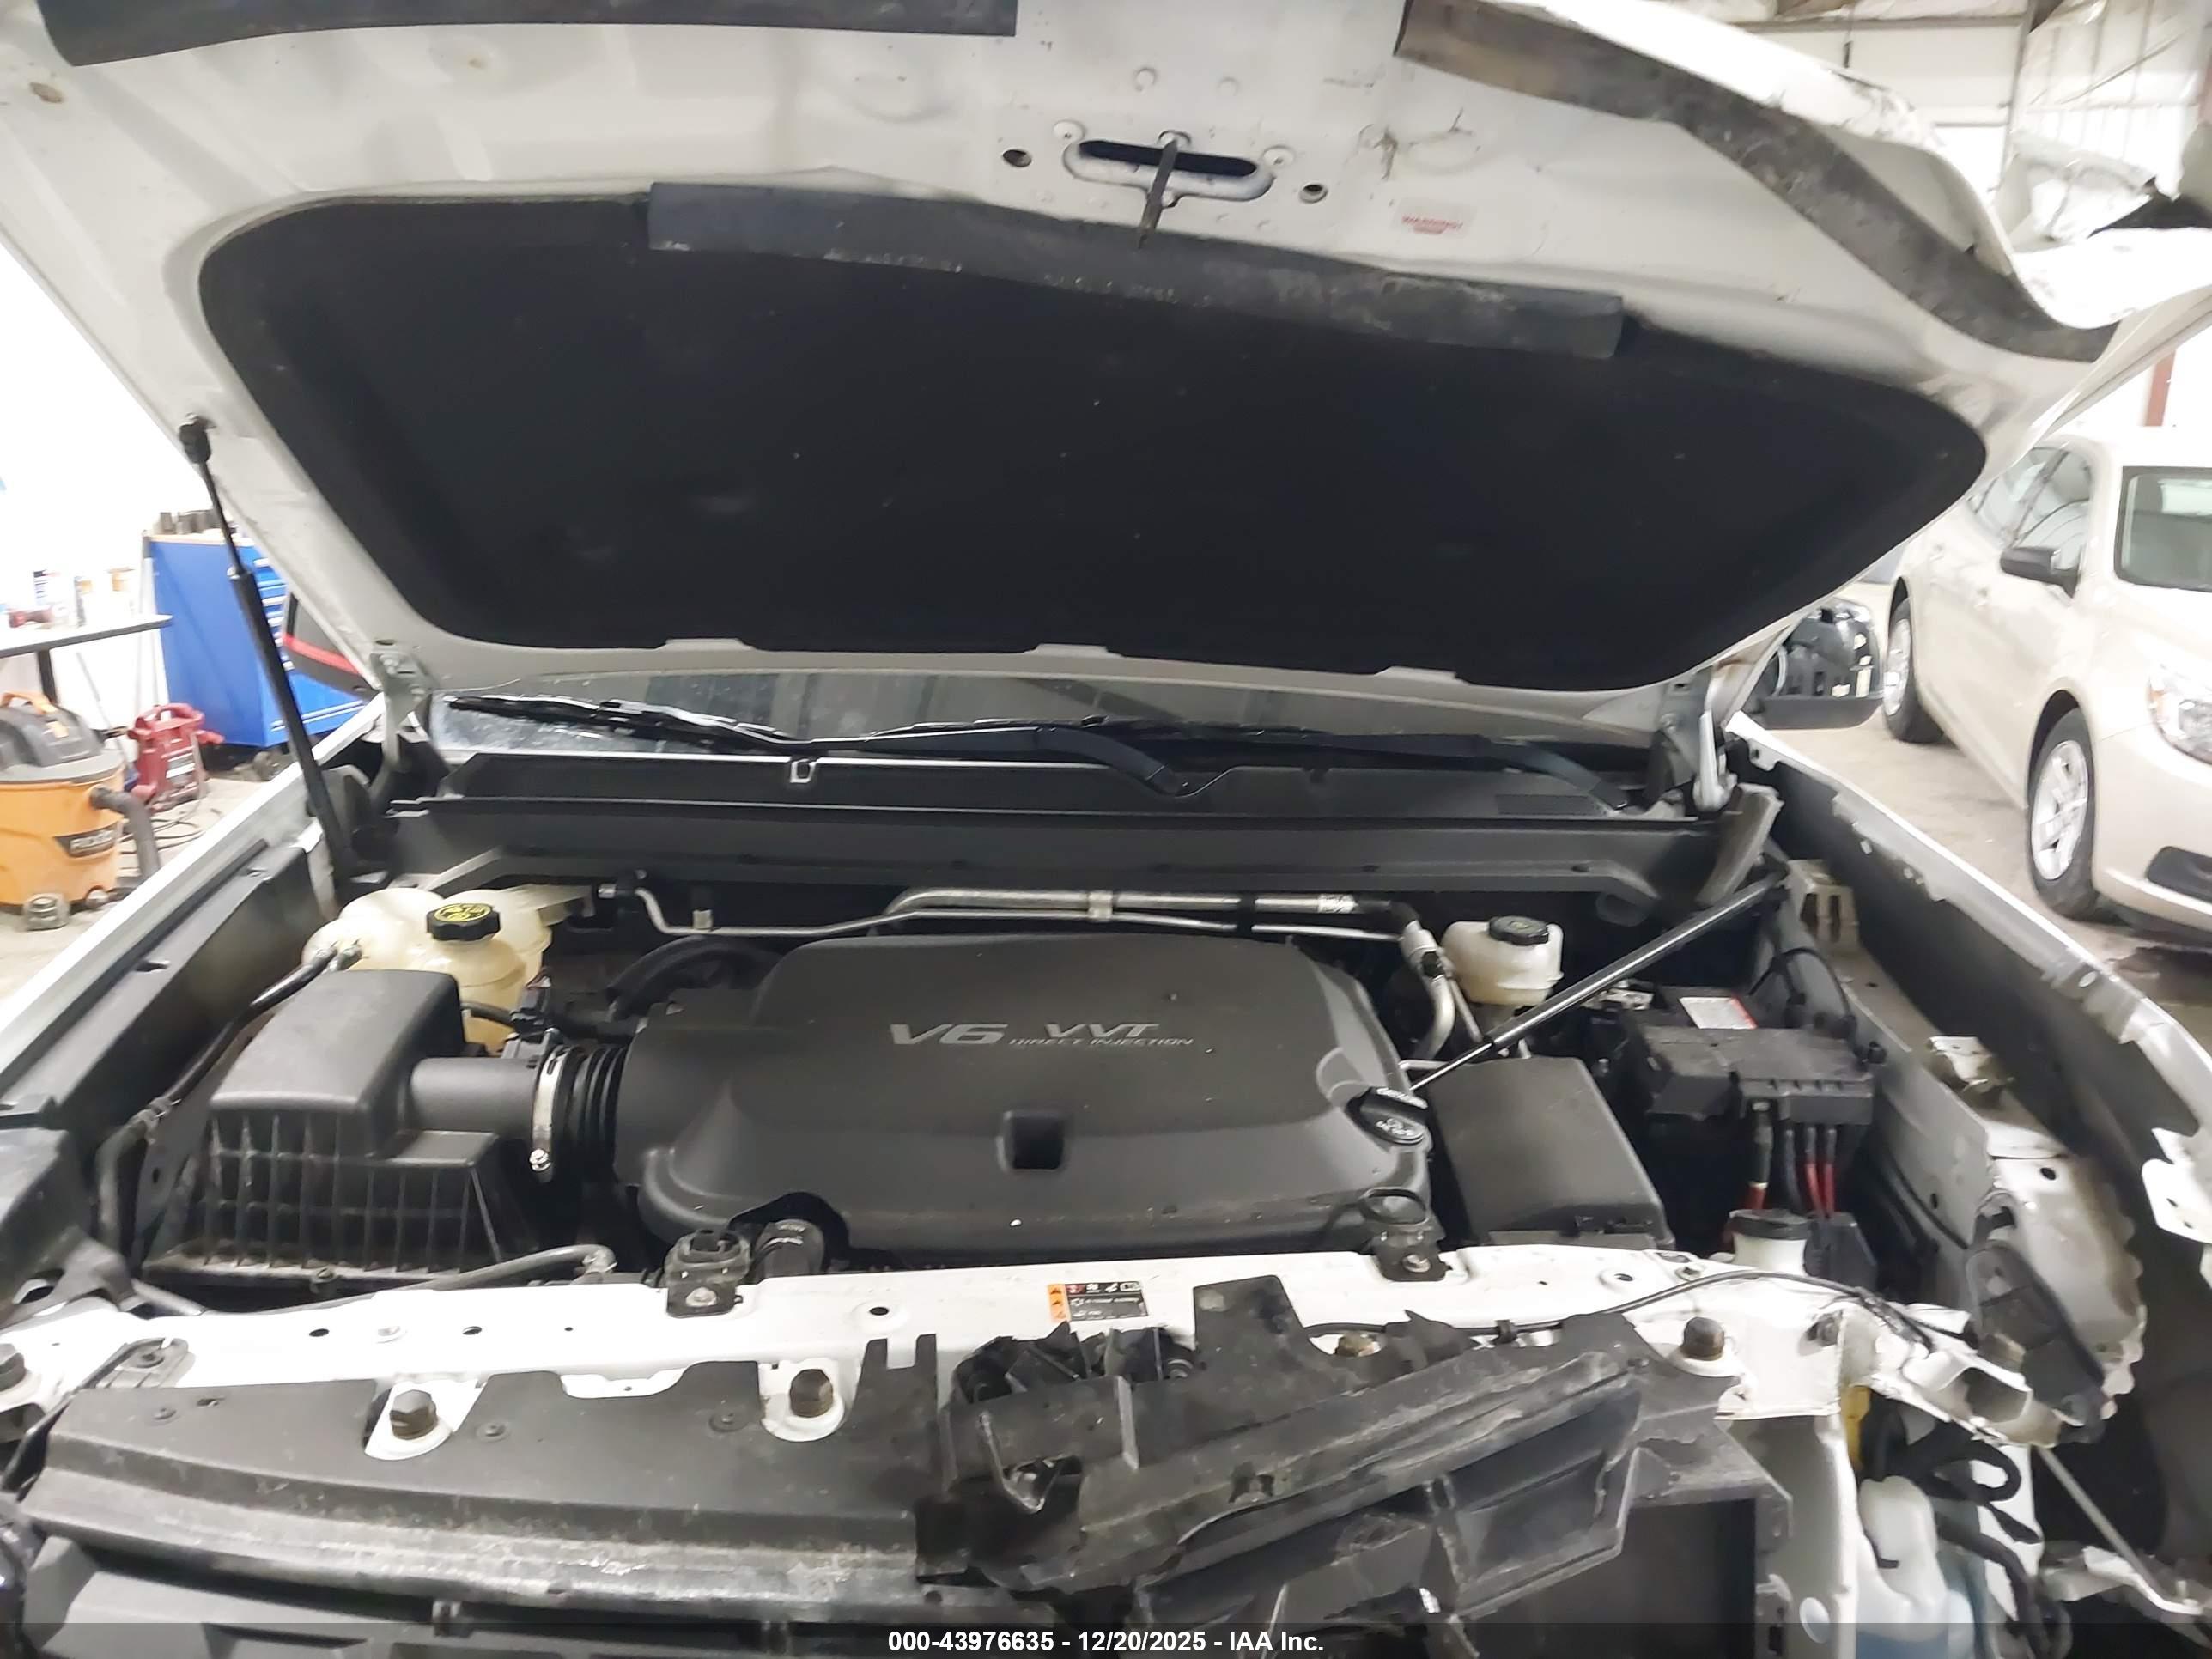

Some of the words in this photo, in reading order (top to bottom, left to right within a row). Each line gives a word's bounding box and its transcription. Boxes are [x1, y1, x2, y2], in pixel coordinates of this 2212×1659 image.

[890, 1023, 1008, 1045] V6
[1044, 1023, 1160, 1038] VVT
[1089, 1037, 1194, 1046] INJECTION
